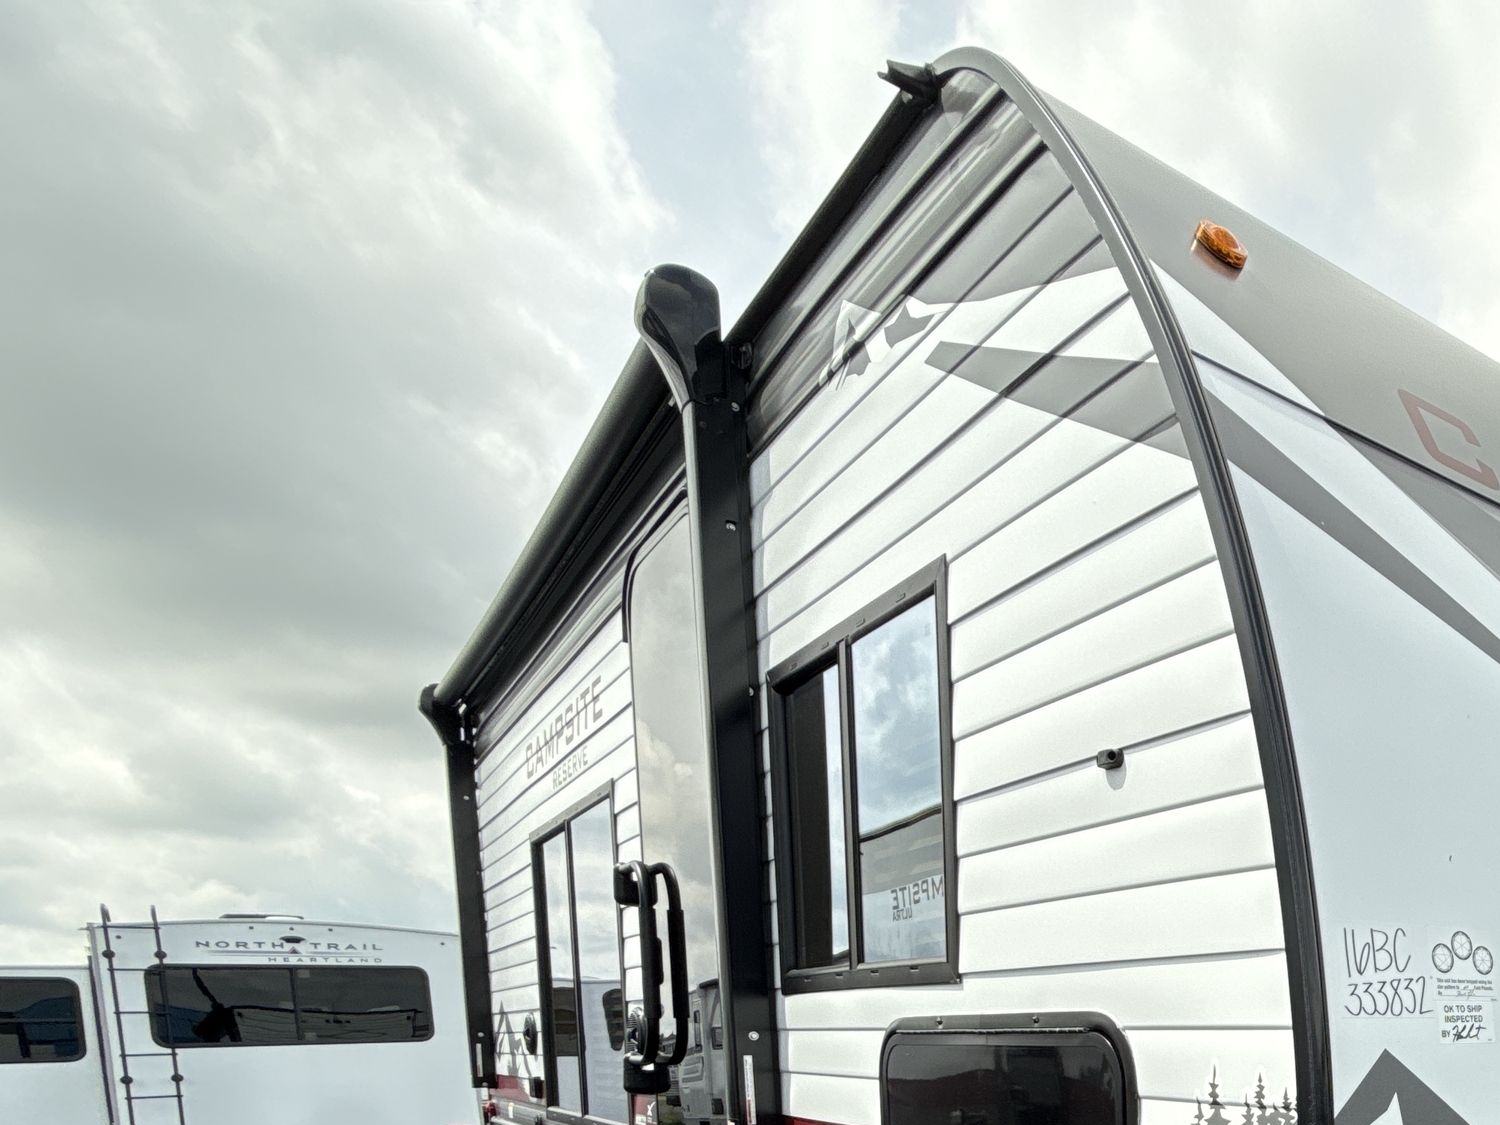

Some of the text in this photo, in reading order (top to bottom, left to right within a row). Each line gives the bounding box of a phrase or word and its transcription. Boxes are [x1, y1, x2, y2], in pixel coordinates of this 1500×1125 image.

[525, 675, 604, 780] CAMPSITE
[552, 744, 589, 791] RESERVE
[195, 940, 385, 951] NORTH TRAIL
[1343, 927, 1411, 978] 16BC
[267, 956, 383, 964] HEARTLAND
[1443, 1004, 1483, 1013] OK TO SHIP
[1444, 1014, 1483, 1023] INSPECTED
[1441, 1030, 1451, 1038] BY
